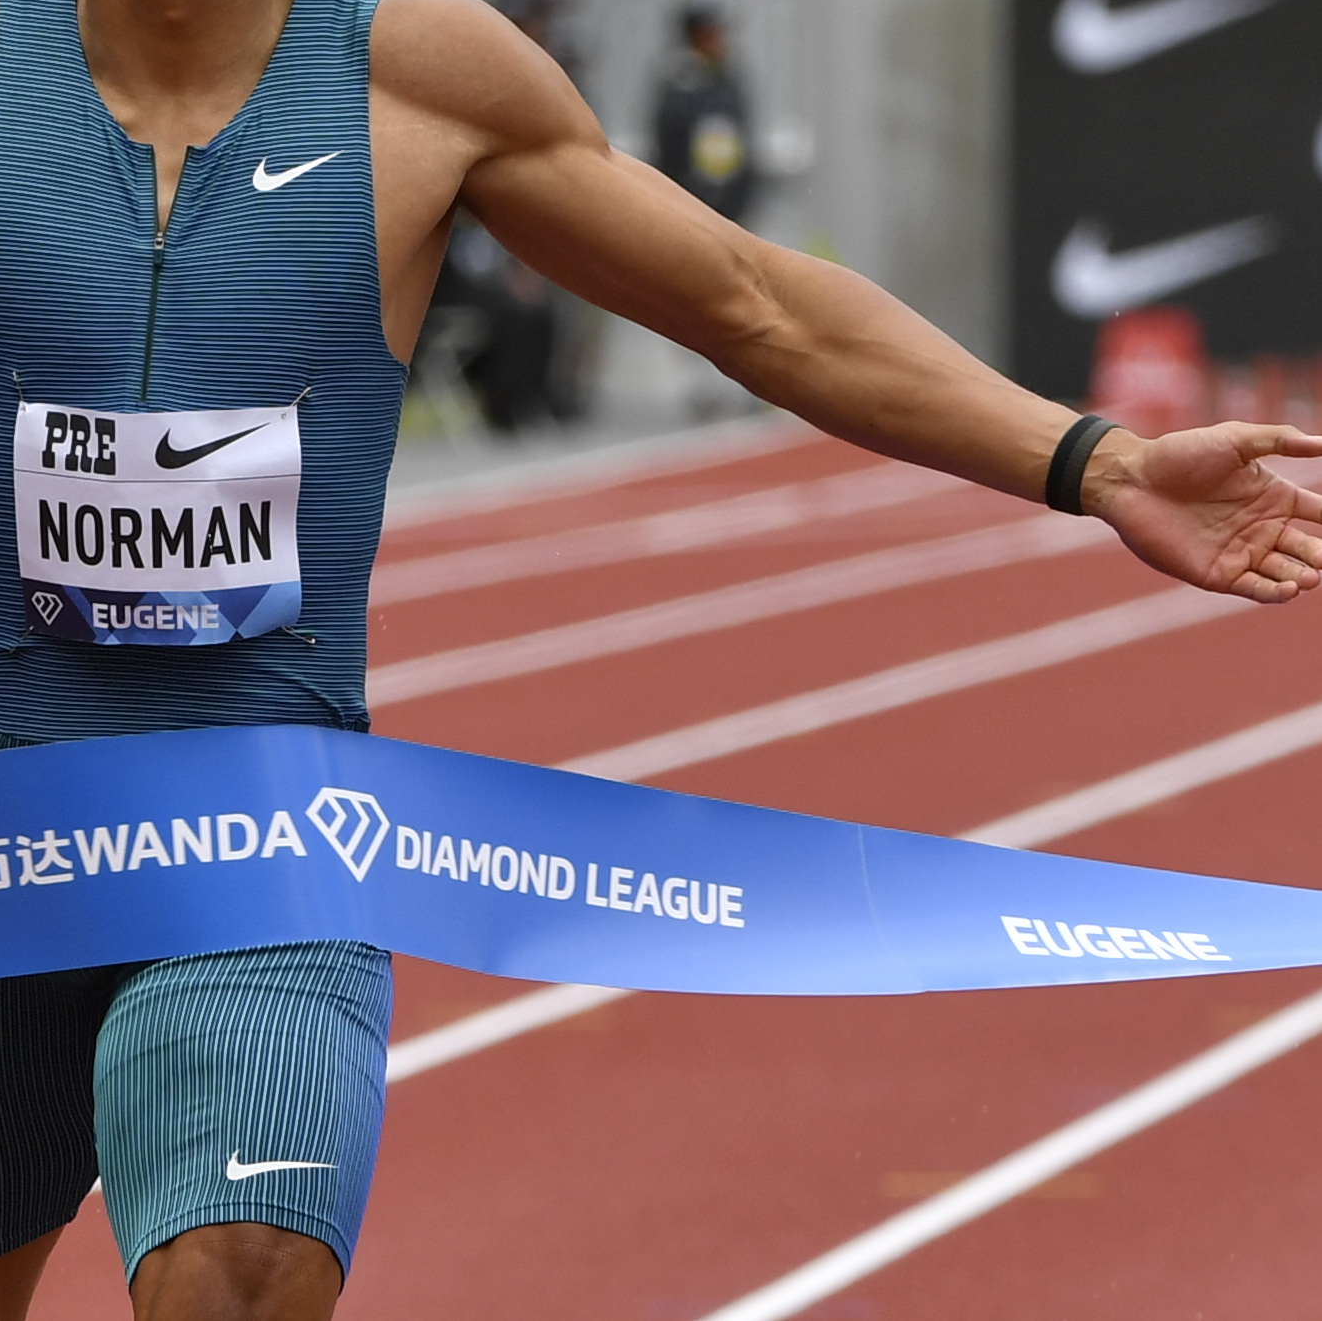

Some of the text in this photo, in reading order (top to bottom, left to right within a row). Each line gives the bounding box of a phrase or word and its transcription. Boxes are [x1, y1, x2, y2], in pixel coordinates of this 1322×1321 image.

[41, 411, 117, 476] PRE
[38, 499, 272, 569] NORMAN
[92, 602, 219, 630] EUGENE
[72, 809, 745, 928] WANDA DIAMOND LEAGUE
[1000, 914, 1233, 962] EUGENE
